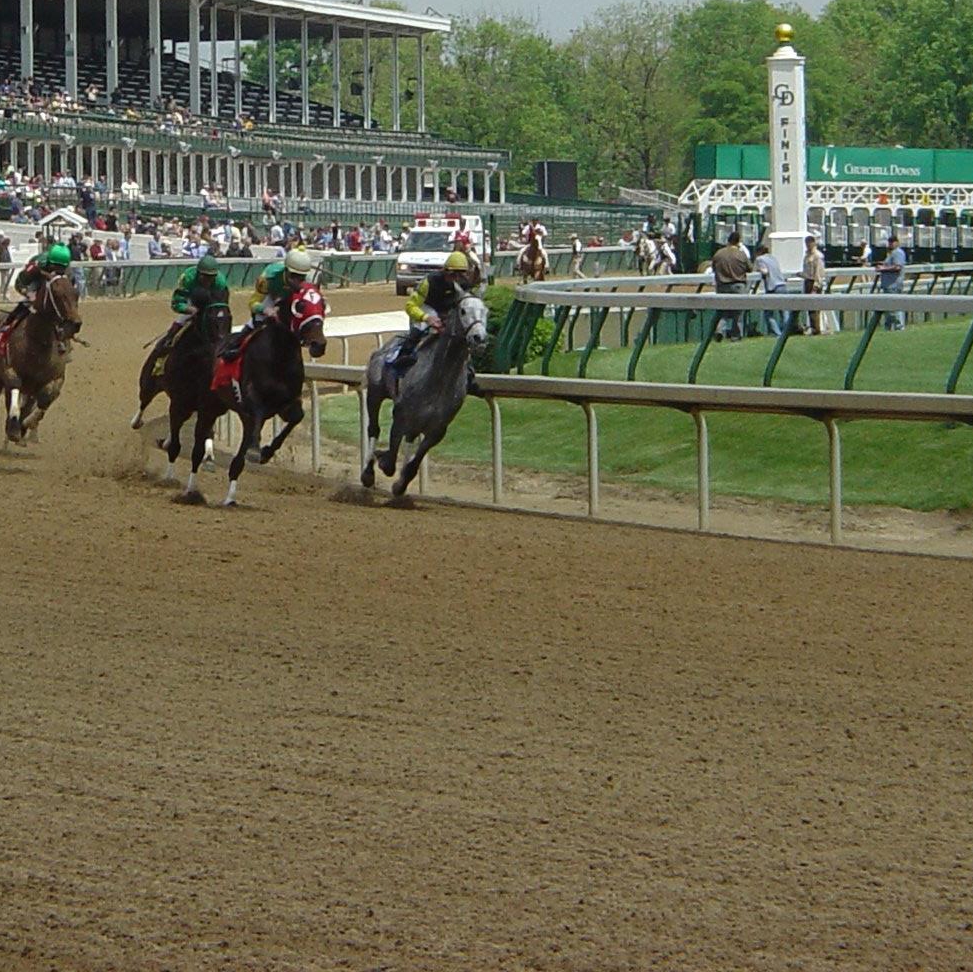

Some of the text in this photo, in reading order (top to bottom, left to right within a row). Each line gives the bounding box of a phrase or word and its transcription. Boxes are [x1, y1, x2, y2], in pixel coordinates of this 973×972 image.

[780, 117, 790, 184] FINISH
[844, 163, 921, 176] CHURCHILL DOWNS
